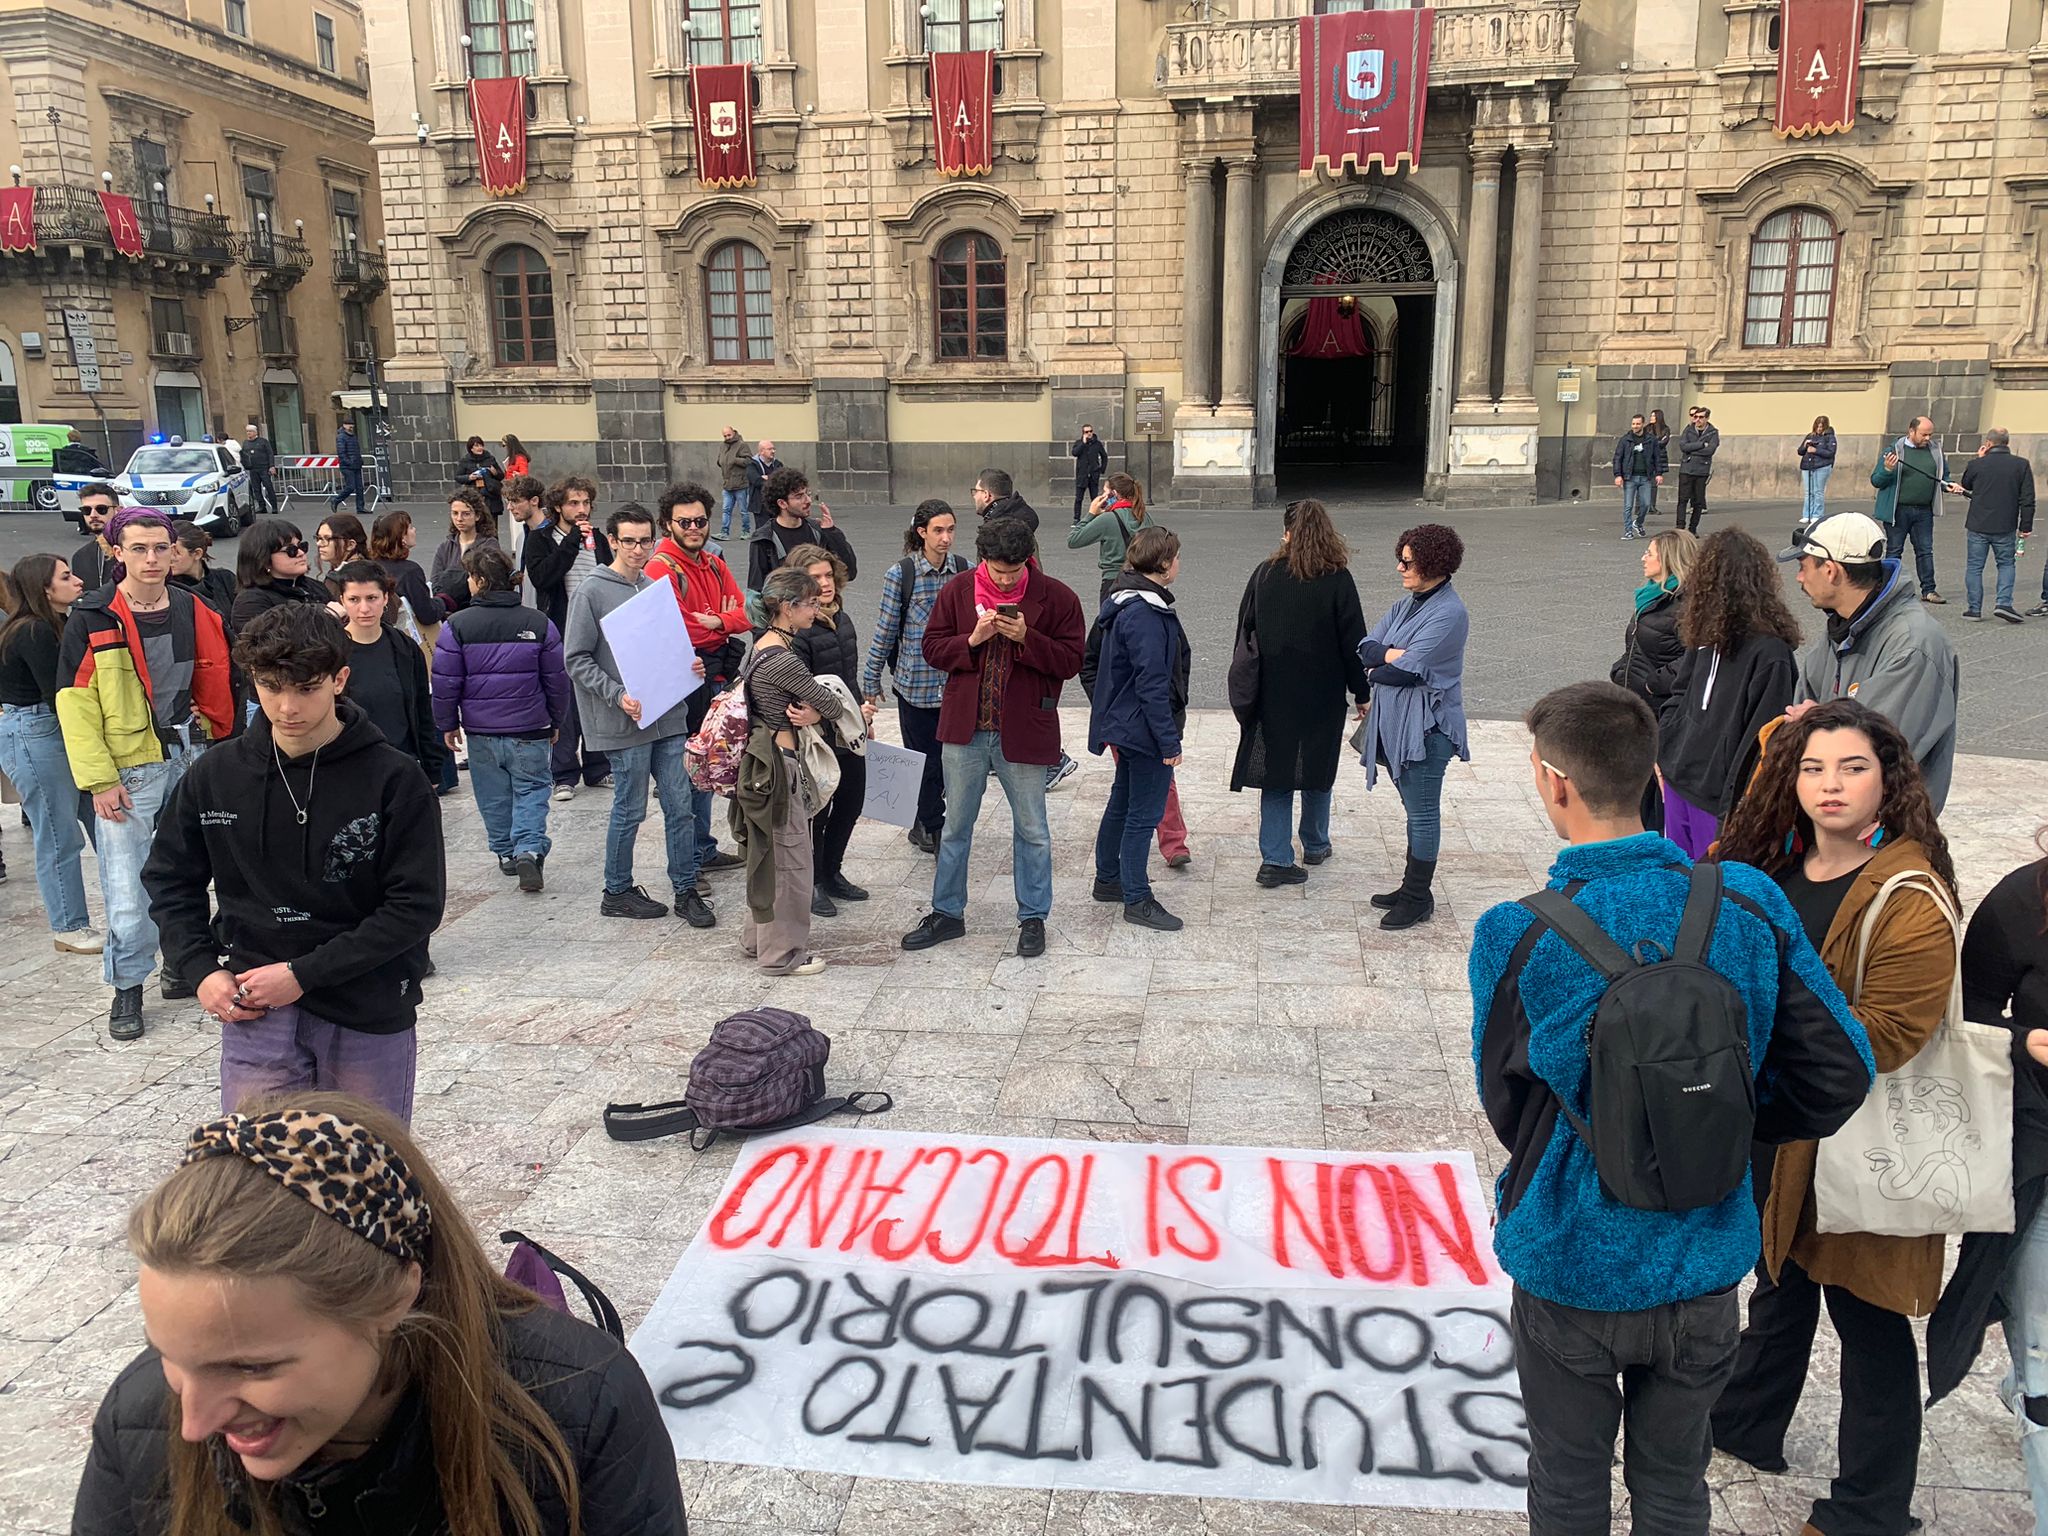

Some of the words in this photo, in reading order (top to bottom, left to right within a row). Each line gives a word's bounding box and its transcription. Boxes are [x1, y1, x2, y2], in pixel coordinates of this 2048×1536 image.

[1804, 49, 1830, 81] A
[496, 122, 514, 148] A
[954, 99, 972, 126] A
[7, 201, 27, 236] A
[117, 207, 136, 242] A
[1319, 329, 1342, 353] A
[709, 1145, 1120, 1270] TOCCANO
[1147, 1156, 1222, 1262] SI
[1268, 1158, 1490, 1287] NON
[729, 1270, 1516, 1379] CONSULTORIO
[658, 1340, 756, 1409] e
[802, 1355, 1531, 1488] STUDENTATO
